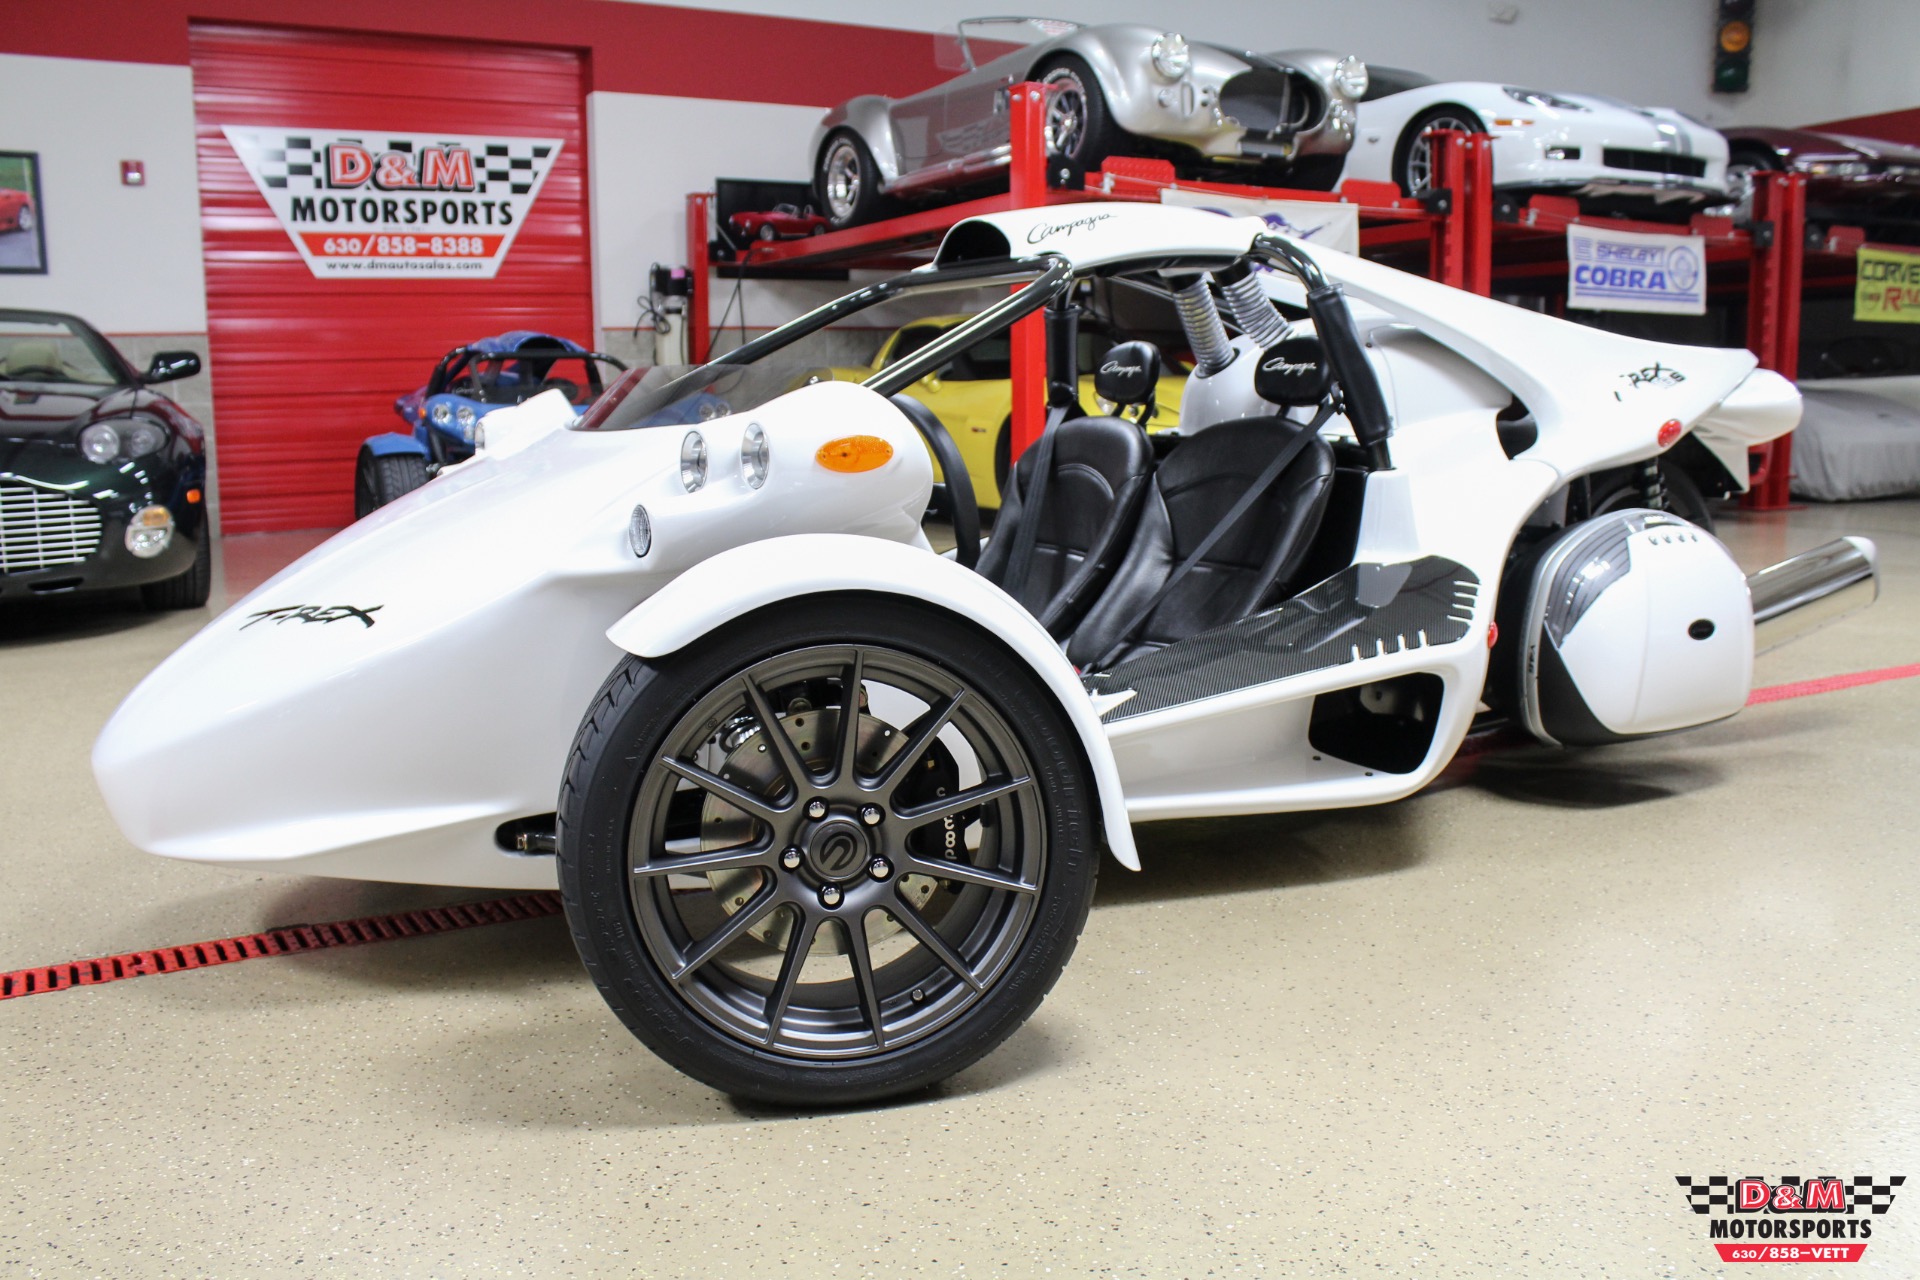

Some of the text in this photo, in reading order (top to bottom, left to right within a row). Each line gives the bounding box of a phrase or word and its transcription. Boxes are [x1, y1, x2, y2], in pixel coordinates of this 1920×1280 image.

[325, 143, 475, 190] D&M
[291, 197, 513, 225] MOTORSPORTS
[1575, 264, 1666, 290] COBRA
[239, 604, 384, 629] T-REX
